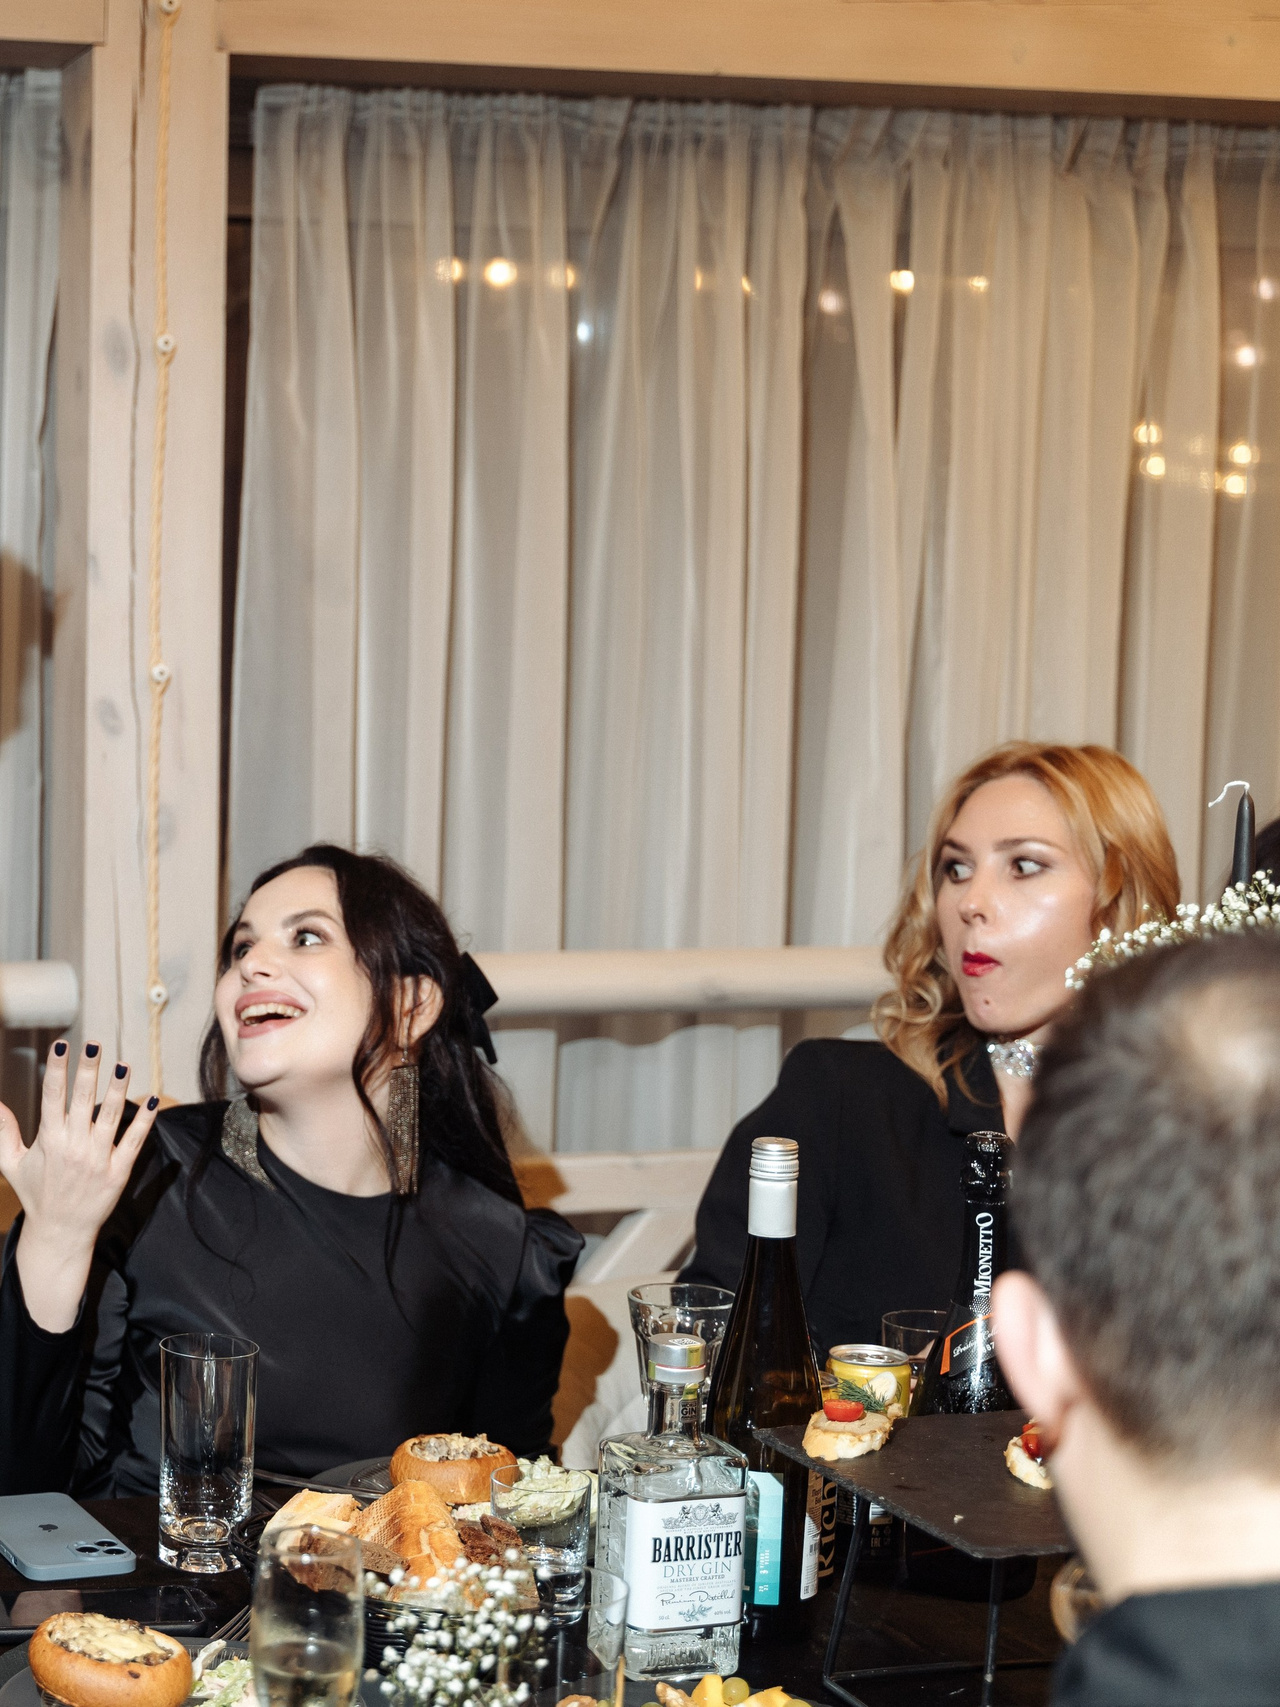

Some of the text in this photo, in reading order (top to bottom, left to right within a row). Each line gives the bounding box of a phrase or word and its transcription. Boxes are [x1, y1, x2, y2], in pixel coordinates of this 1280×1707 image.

[682, 1407, 697, 1416] GIN
[651, 1530, 742, 1563] BARRISTER
[663, 1561, 732, 1578] DRY GIN
